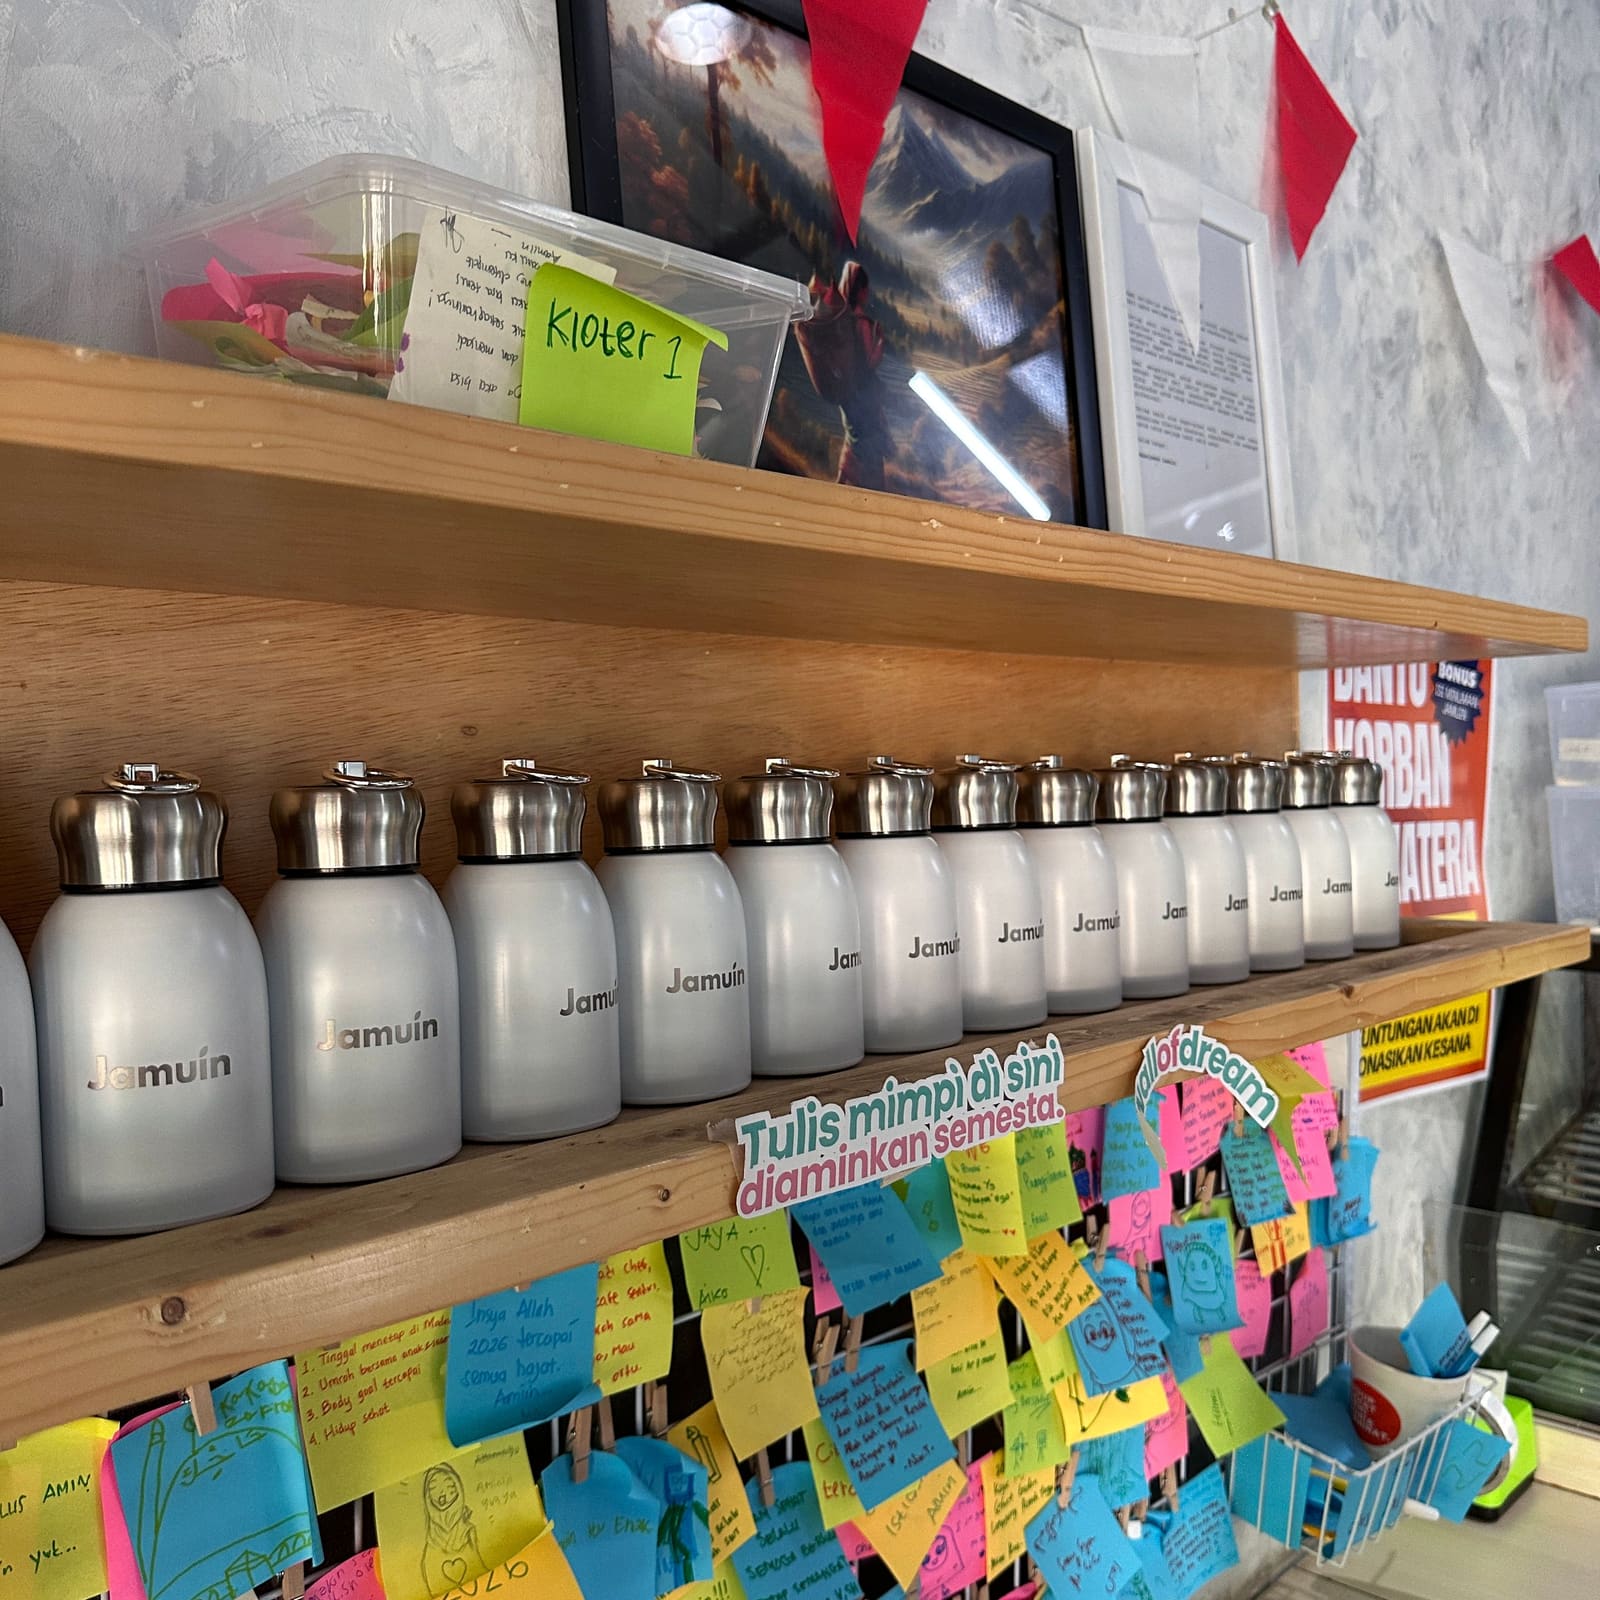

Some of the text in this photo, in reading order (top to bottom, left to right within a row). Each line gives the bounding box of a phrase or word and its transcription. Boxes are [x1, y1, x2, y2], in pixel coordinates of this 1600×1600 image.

[546, 297, 683, 380] Kloter 1
[1437, 659, 1478, 690] BONUS
[1396, 817, 1480, 903] ATERA
[1431, 1008, 1466, 1031] AKAN
[1467, 1005, 1480, 1025] DI
[1425, 1033, 1471, 1060] KESANA
[741, 1038, 1061, 1169] Tulis mimpi di sini
[740, 1130, 928, 1215] diaminkan
[934, 1092, 1065, 1154] semesta.
[318, 1342, 358, 1368] Tinggal
[361, 1330, 405, 1353] menetap
[320, 1396, 353, 1417] Body
[323, 1420, 358, 1441] Hidup
